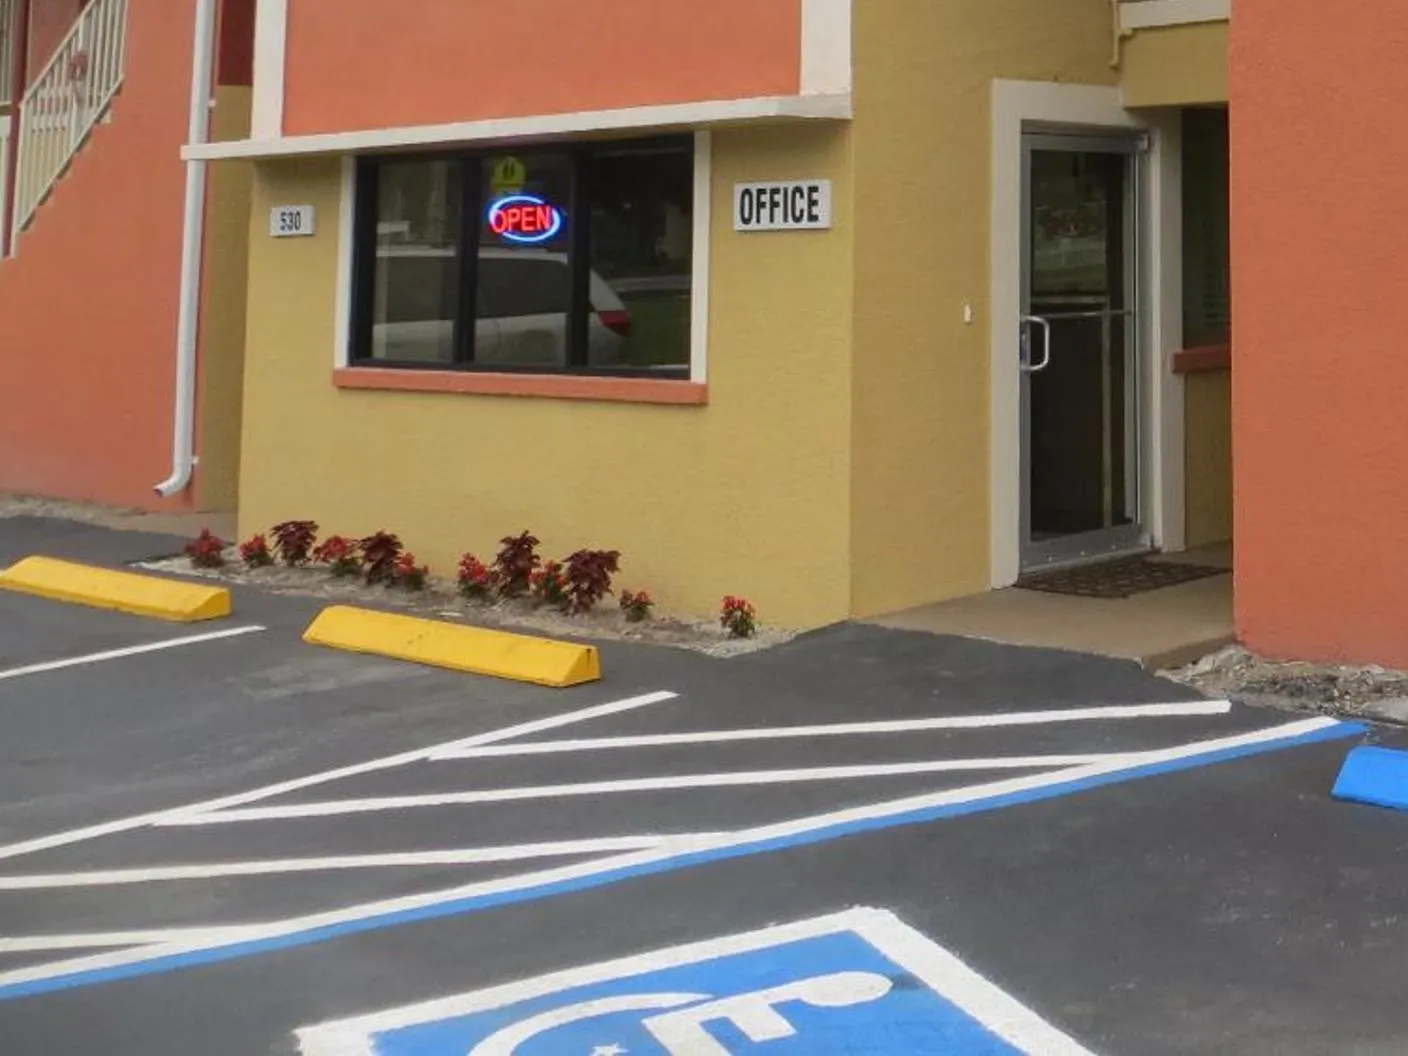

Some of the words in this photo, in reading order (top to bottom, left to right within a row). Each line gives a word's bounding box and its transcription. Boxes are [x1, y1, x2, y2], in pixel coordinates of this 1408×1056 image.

[490, 204, 551, 233] OPEN
[740, 185, 819, 225] OFFICE
[280, 210, 301, 231] 530
